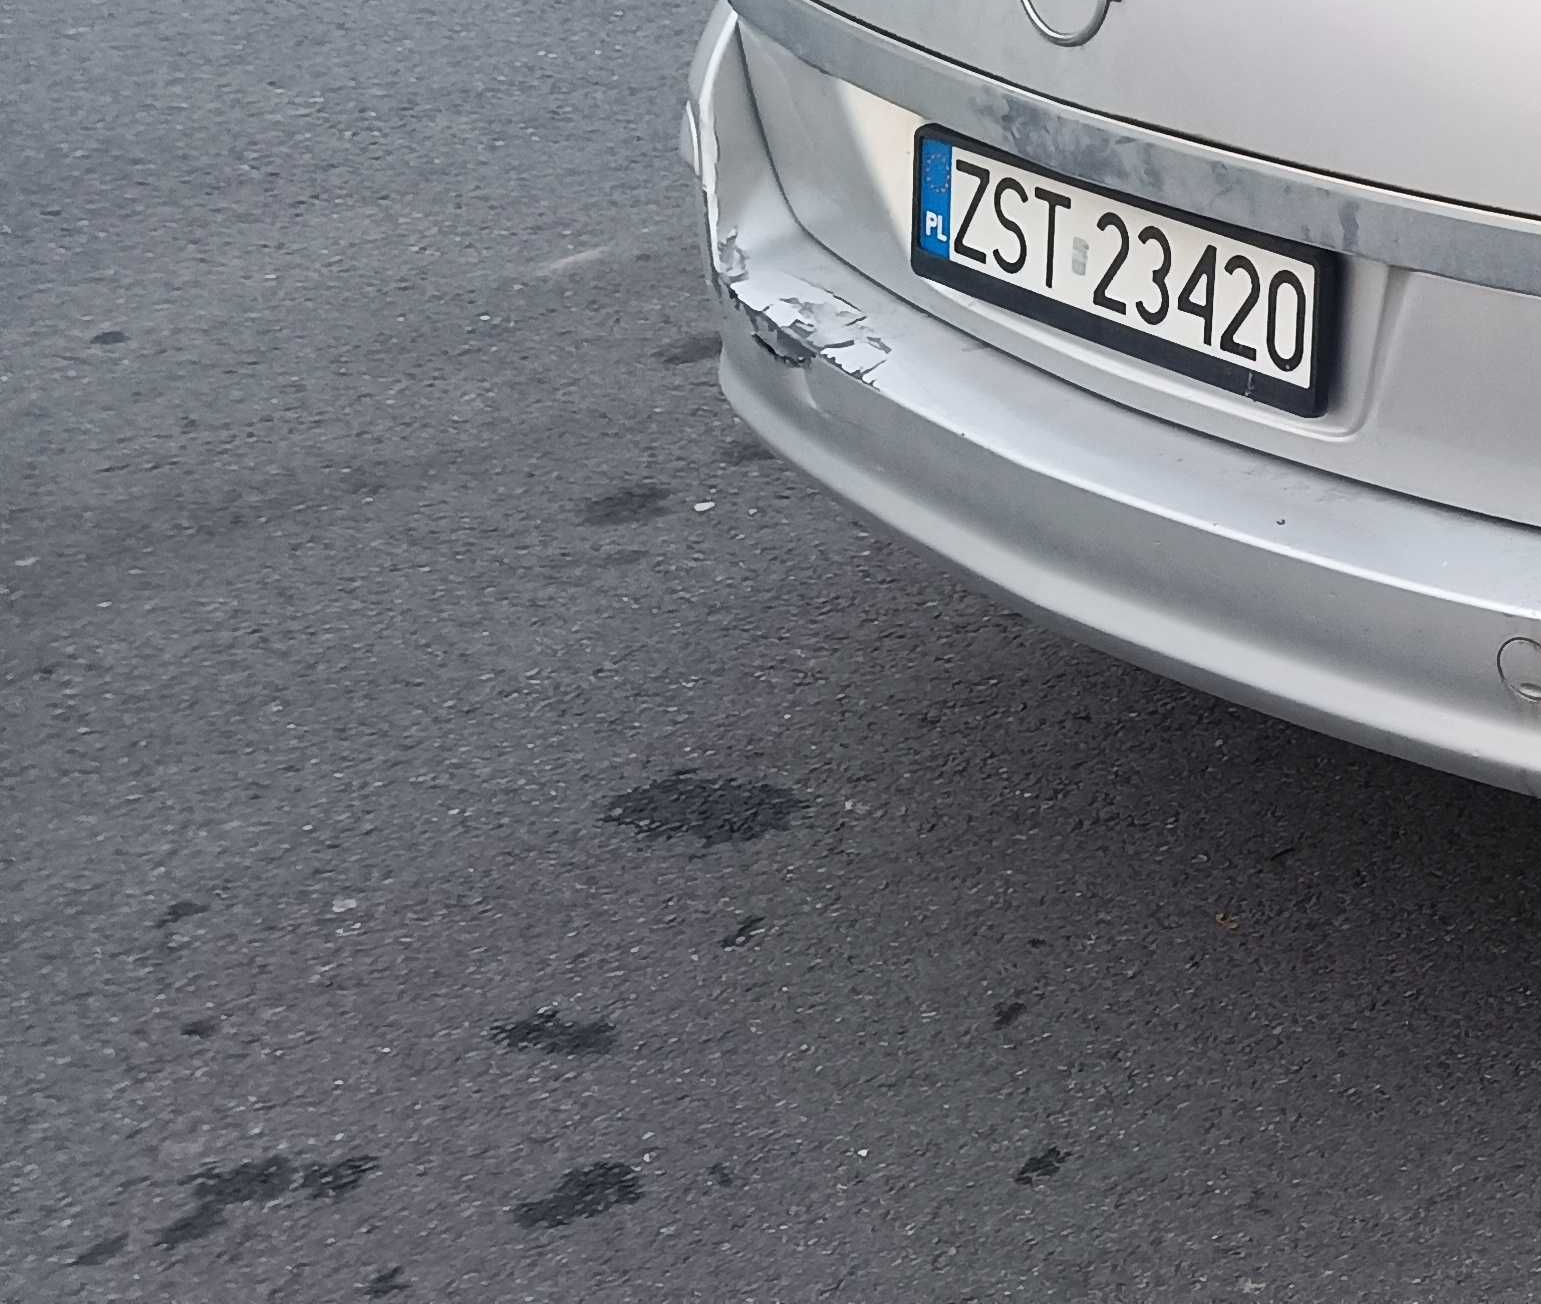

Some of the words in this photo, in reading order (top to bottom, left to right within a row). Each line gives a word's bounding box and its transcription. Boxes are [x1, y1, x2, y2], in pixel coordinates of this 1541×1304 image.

[926, 210, 947, 242] PL
[953, 159, 1072, 289] ZST
[1092, 211, 1308, 373] 23420
